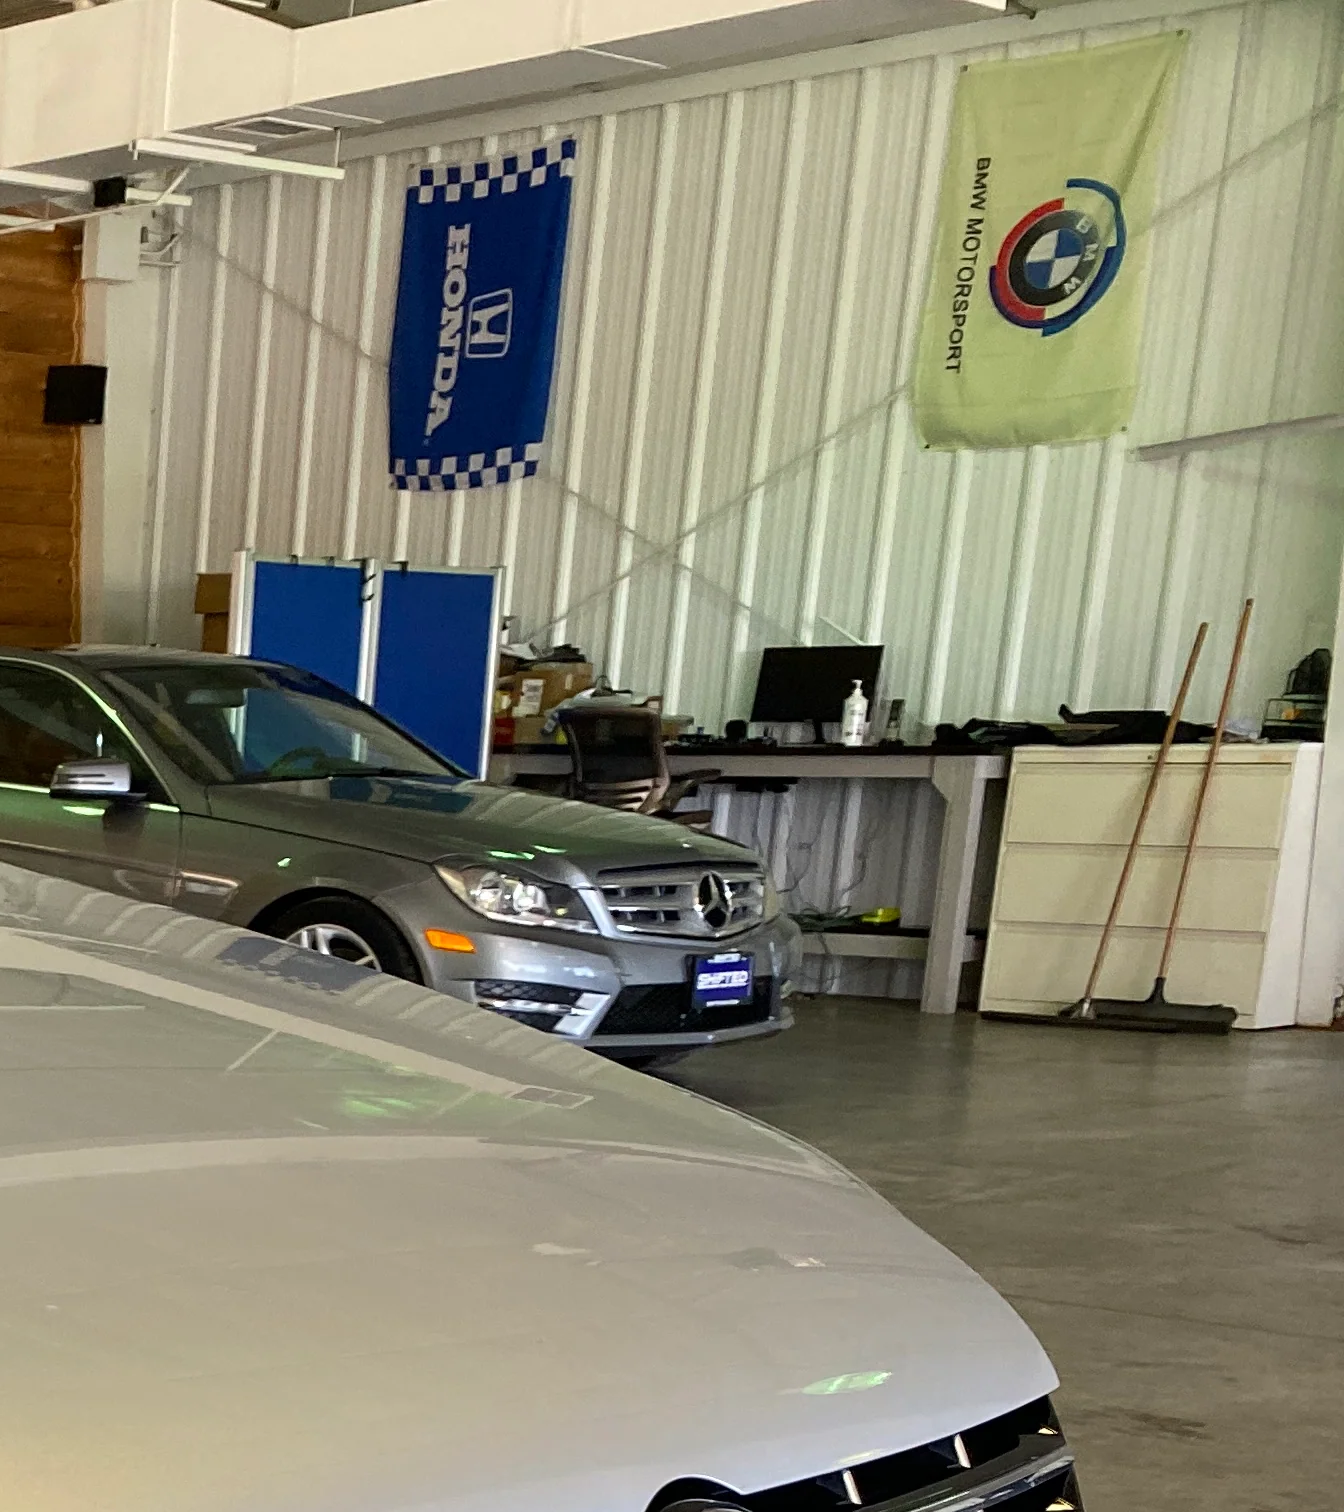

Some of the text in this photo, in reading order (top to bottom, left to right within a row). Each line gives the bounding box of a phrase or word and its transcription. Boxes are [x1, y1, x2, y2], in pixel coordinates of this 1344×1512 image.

[425, 222, 471, 437] HONDA
[944, 157, 991, 374] BMW MOTORSPORT
